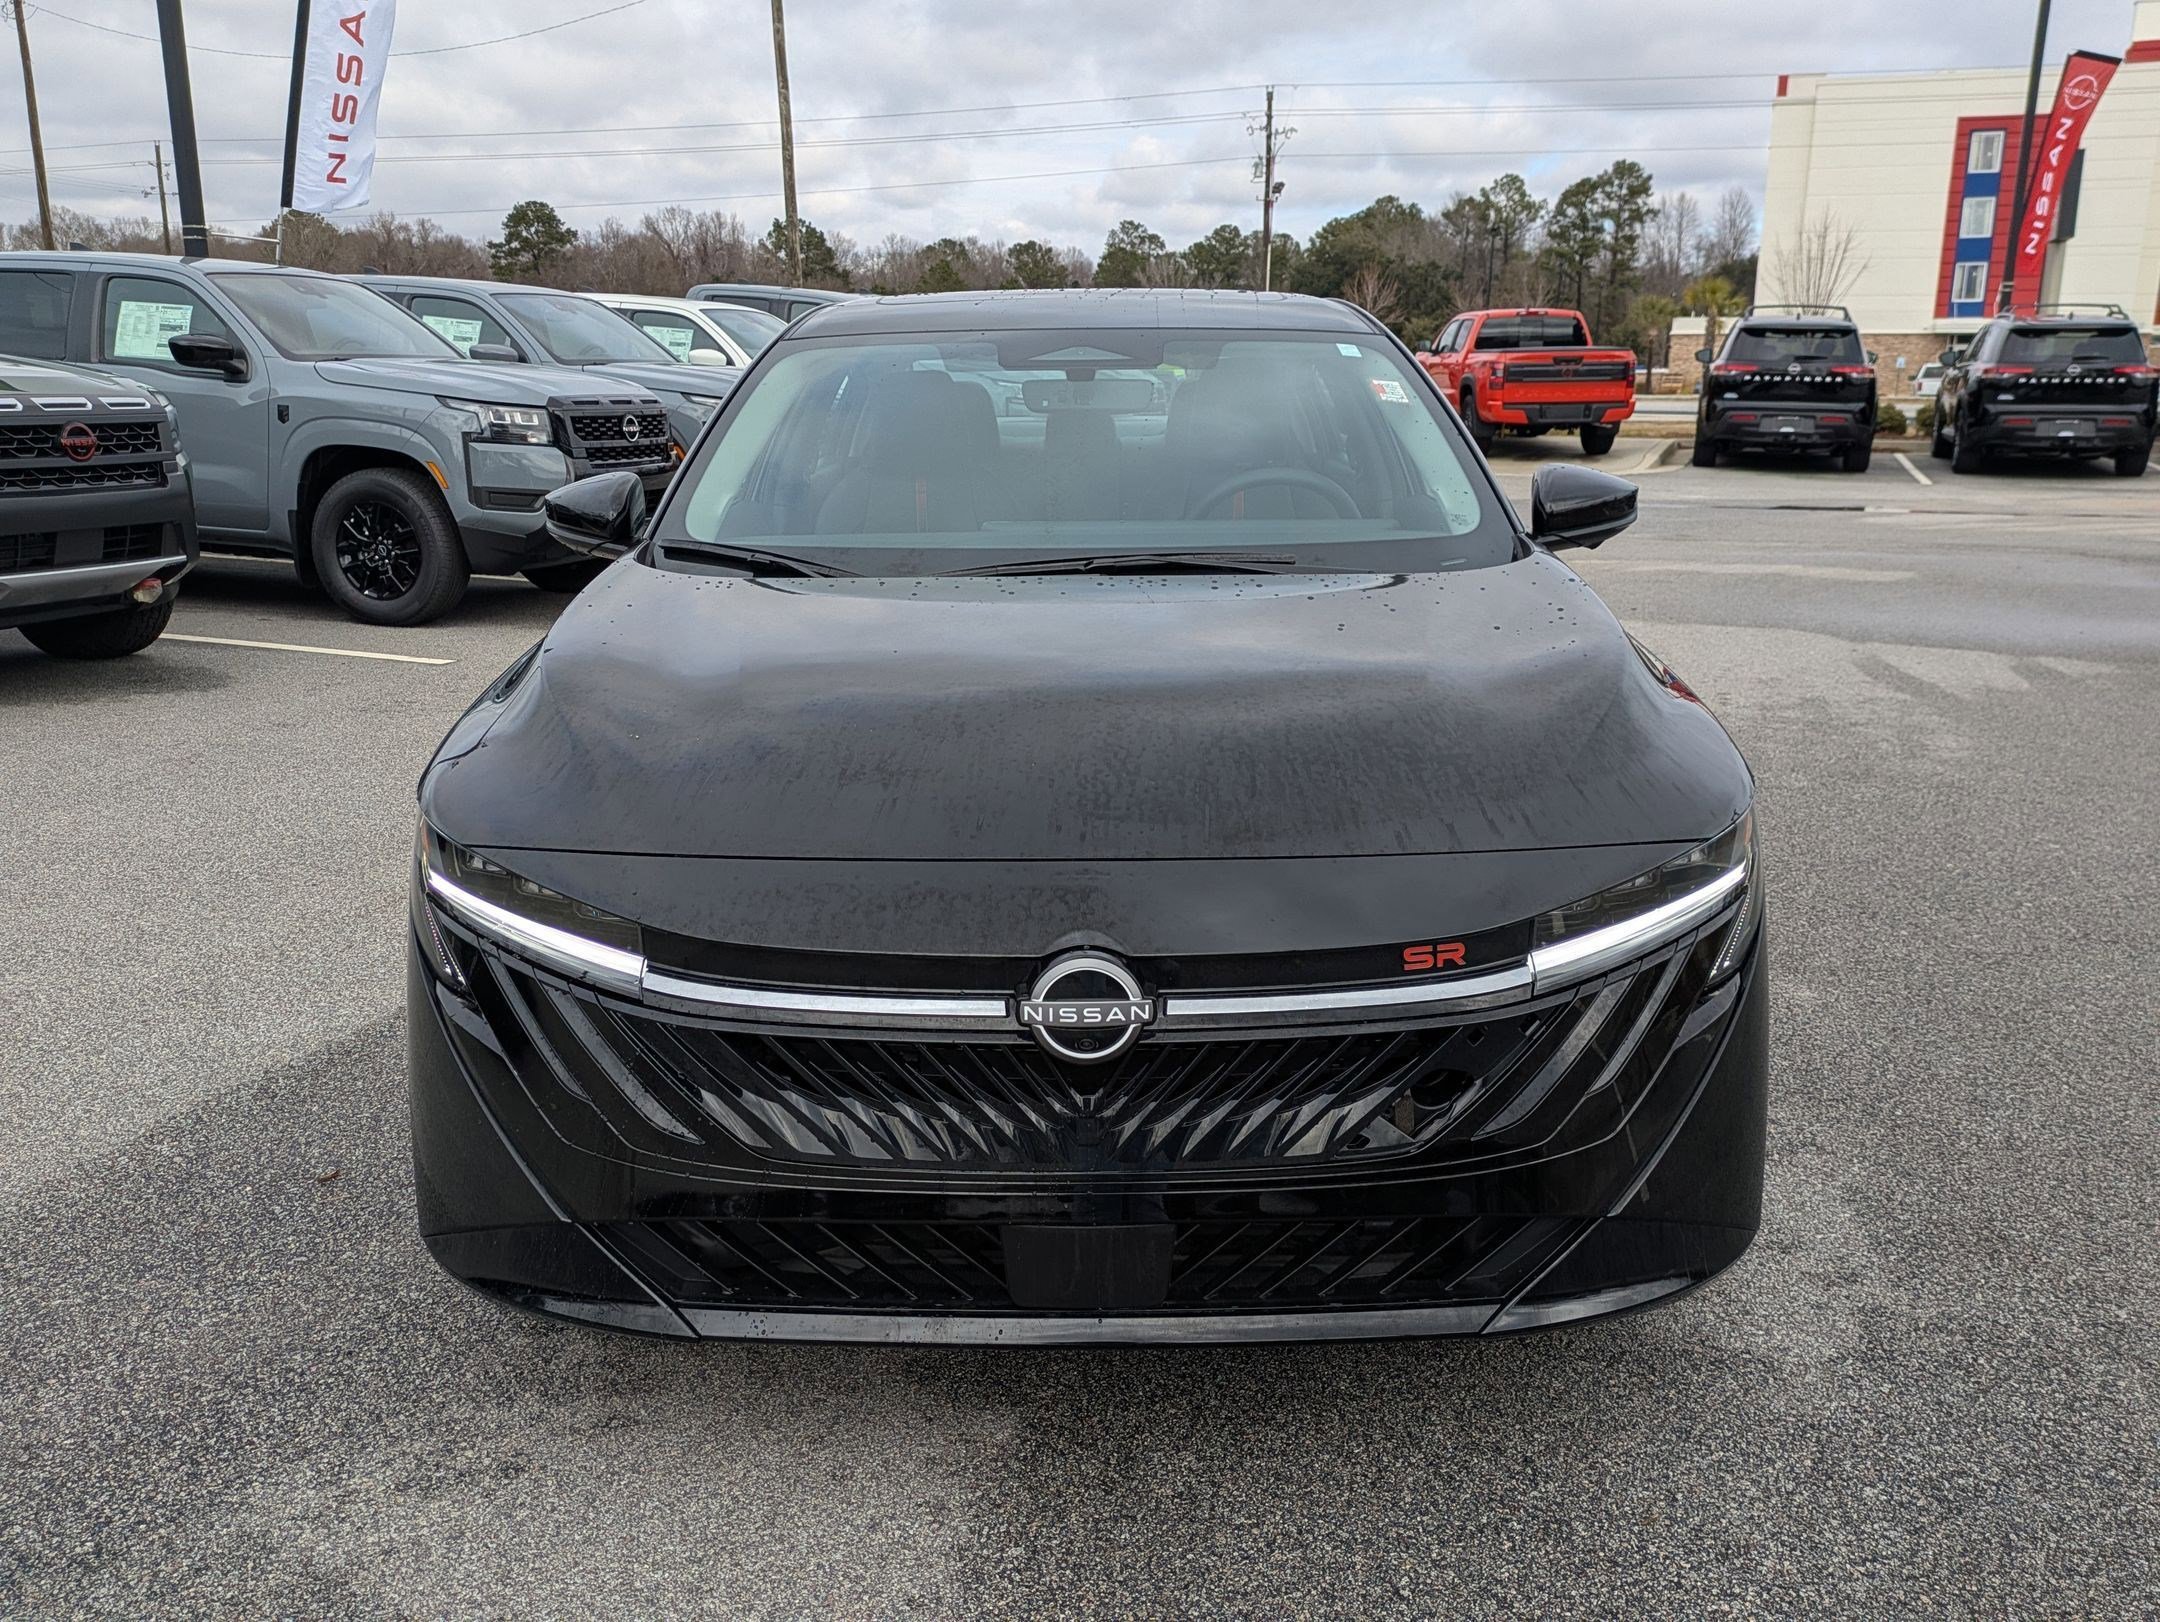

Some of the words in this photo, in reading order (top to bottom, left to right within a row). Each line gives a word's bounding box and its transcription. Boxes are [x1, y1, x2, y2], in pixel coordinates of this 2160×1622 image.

[326, 0, 368, 184] NISSA
[2024, 116, 2075, 255] NISSAN
[1403, 942, 1467, 971] SR
[1023, 1004, 1150, 1023] NISSAN
